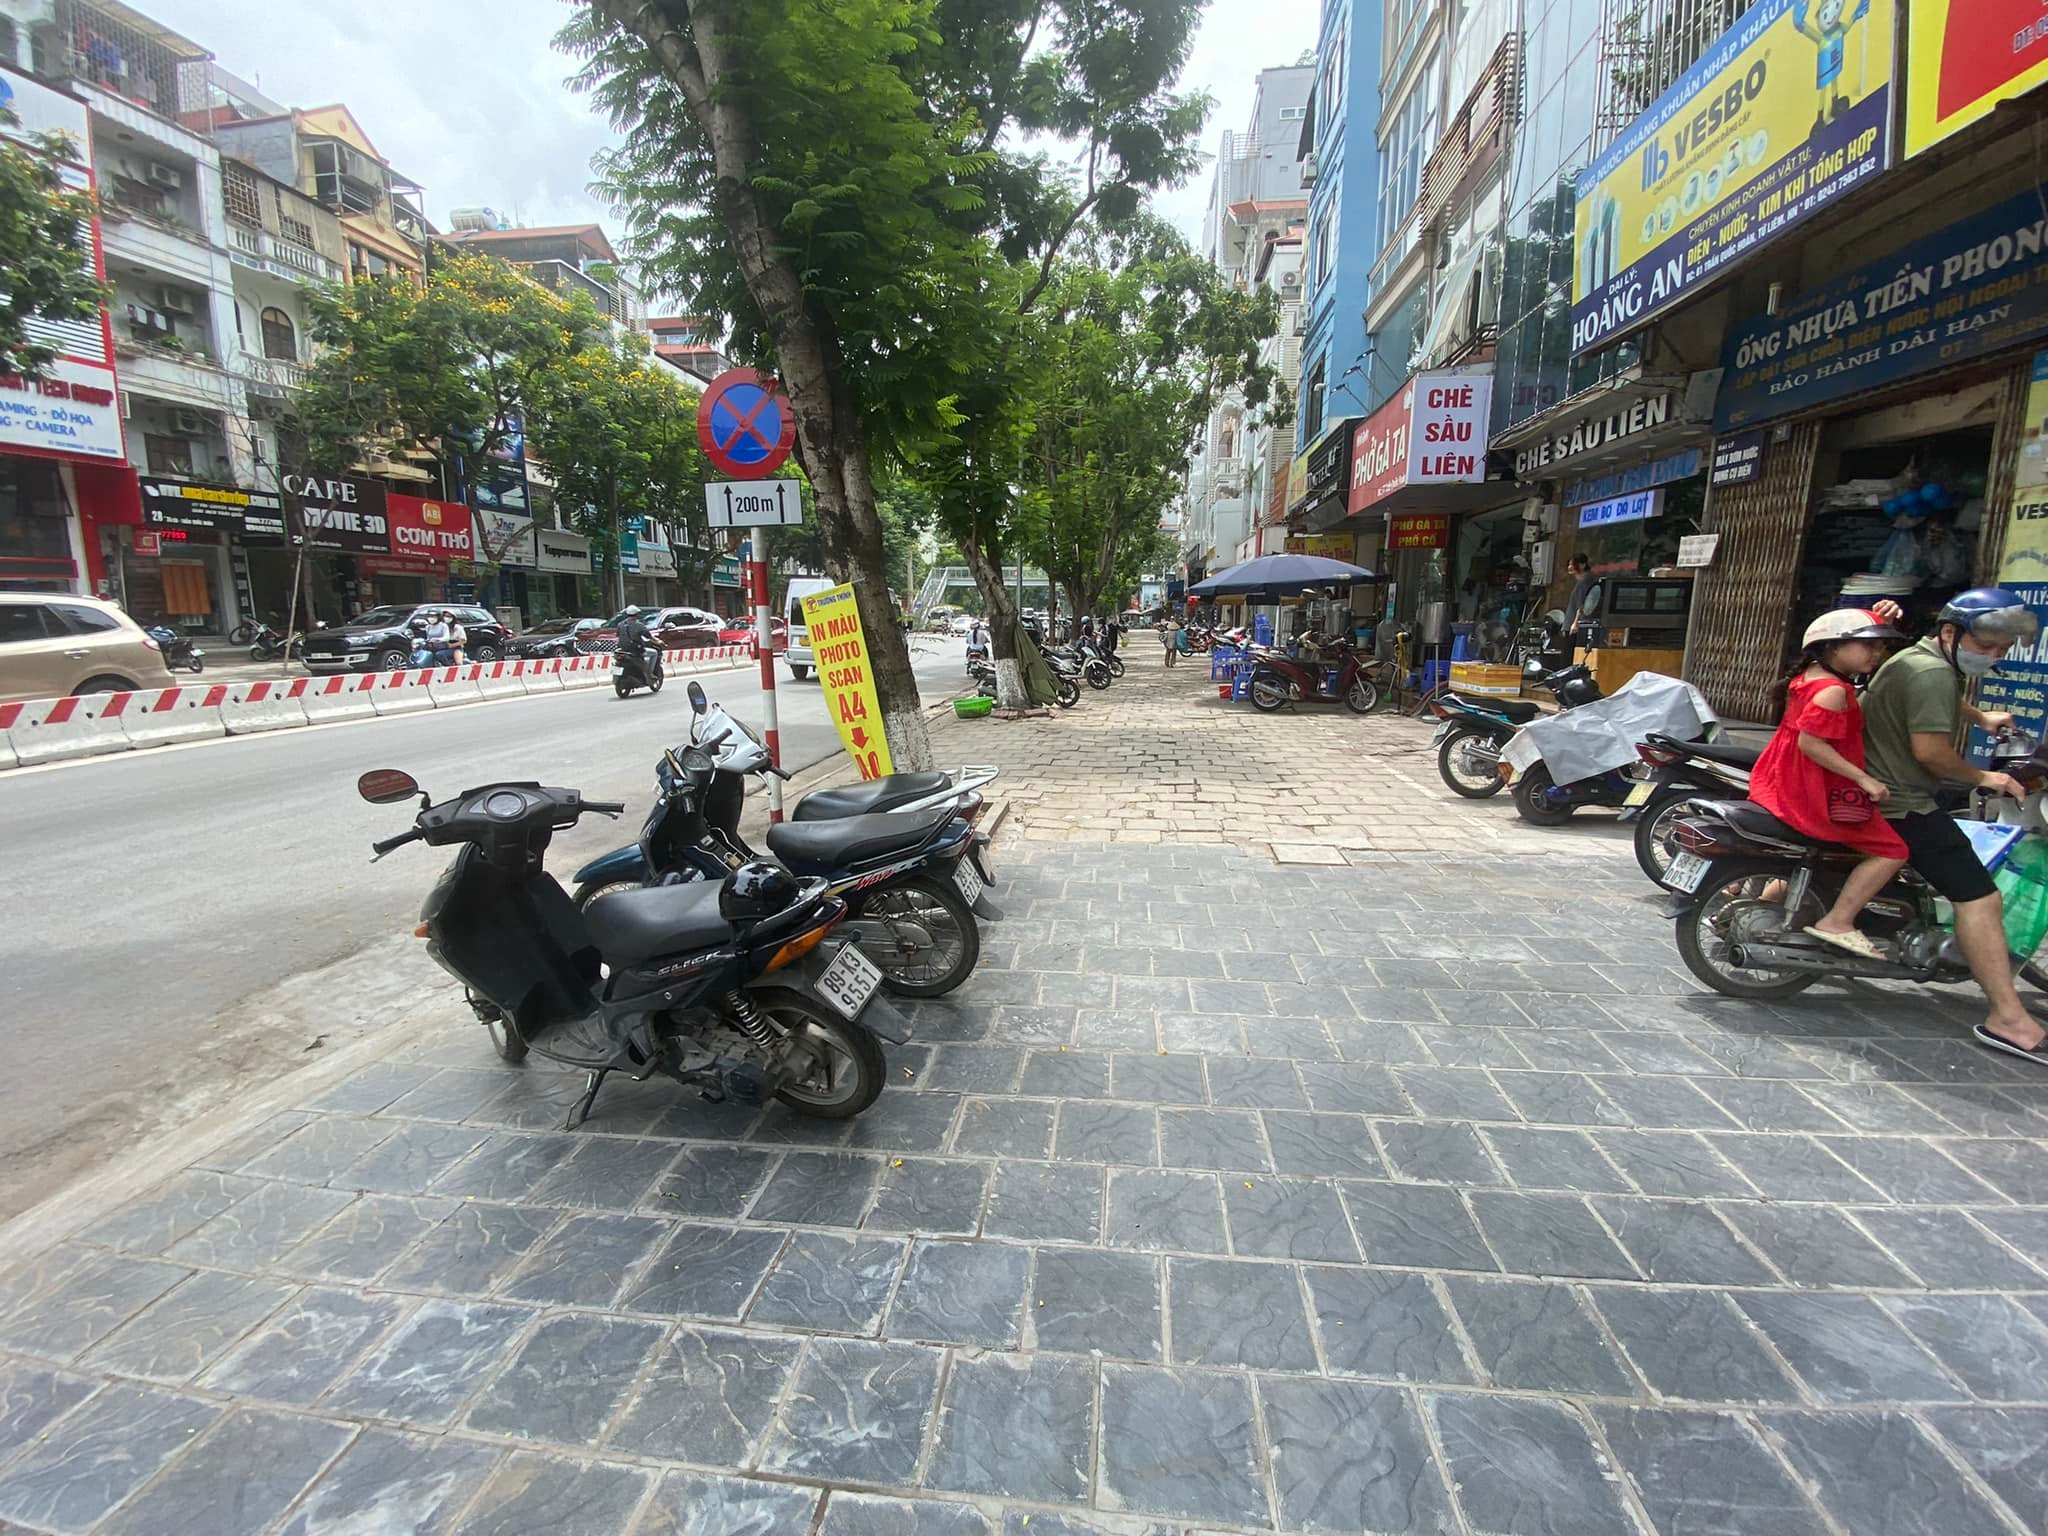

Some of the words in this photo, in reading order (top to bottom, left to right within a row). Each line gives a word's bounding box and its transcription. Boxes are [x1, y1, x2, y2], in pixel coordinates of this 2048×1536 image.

[1674, 59, 1767, 162] VESBO
[1687, 237, 1710, 267] ĐIỆN
[1719, 211, 1748, 247] NƯỚC
[1758, 189, 1781, 222] KIM
[1784, 168, 1806, 205] KHÍ
[1808, 151, 1843, 188] TỔNG
[1847, 126, 1877, 163] HỢP
[1689, 213, 1719, 240] CHUYÊN
[1721, 195, 1741, 217] KINH
[1742, 172, 1776, 205] DOANH
[1572, 282, 1643, 352] HOÀNG
[1648, 254, 1683, 305] AN
[1735, 330, 1781, 369] ỐNG
[1785, 299, 1858, 350] NHỰA
[1864, 262, 1934, 319] TIỀN
[1941, 219, 2048, 289] PHON
[1768, 373, 1809, 396] BẢO
[1815, 346, 1881, 380] HÀNH
[1887, 329, 1937, 356] DÀI
[1944, 303, 2013, 337] HẠN
[1428, 384, 1473, 409] CHÈ
[25, 419, 77, 437] CAMERA
[1425, 414, 1472, 442] SẦU
[1515, 436, 1550, 474] CHÈ
[1554, 419, 1600, 460] SẦU
[1604, 395, 1669, 442] LIÊN
[1353, 436, 1377, 490] PHỞ
[1375, 428, 1390, 476] GÀ
[1392, 424, 1406, 466] TA
[1421, 452, 1474, 476] LIÊN
[283, 474, 358, 503] CAFE
[735, 496, 759, 513] 200
[761, 498, 774, 512] m
[1583, 507, 1598, 523] KEM
[363, 515, 387, 535] 3D
[396, 526, 436, 547] CƠM
[438, 528, 470, 550] THỐ
[811, 622, 826, 643] IN
[828, 613, 858, 639] MÀU
[819, 640, 861, 666] PHOTO
[828, 666, 863, 689] SCAN
[838, 691, 867, 724] A4
[658, 950, 721, 976] CLICK
[823, 951, 861, 995] 89-K3
[841, 966, 878, 1010] 9551
